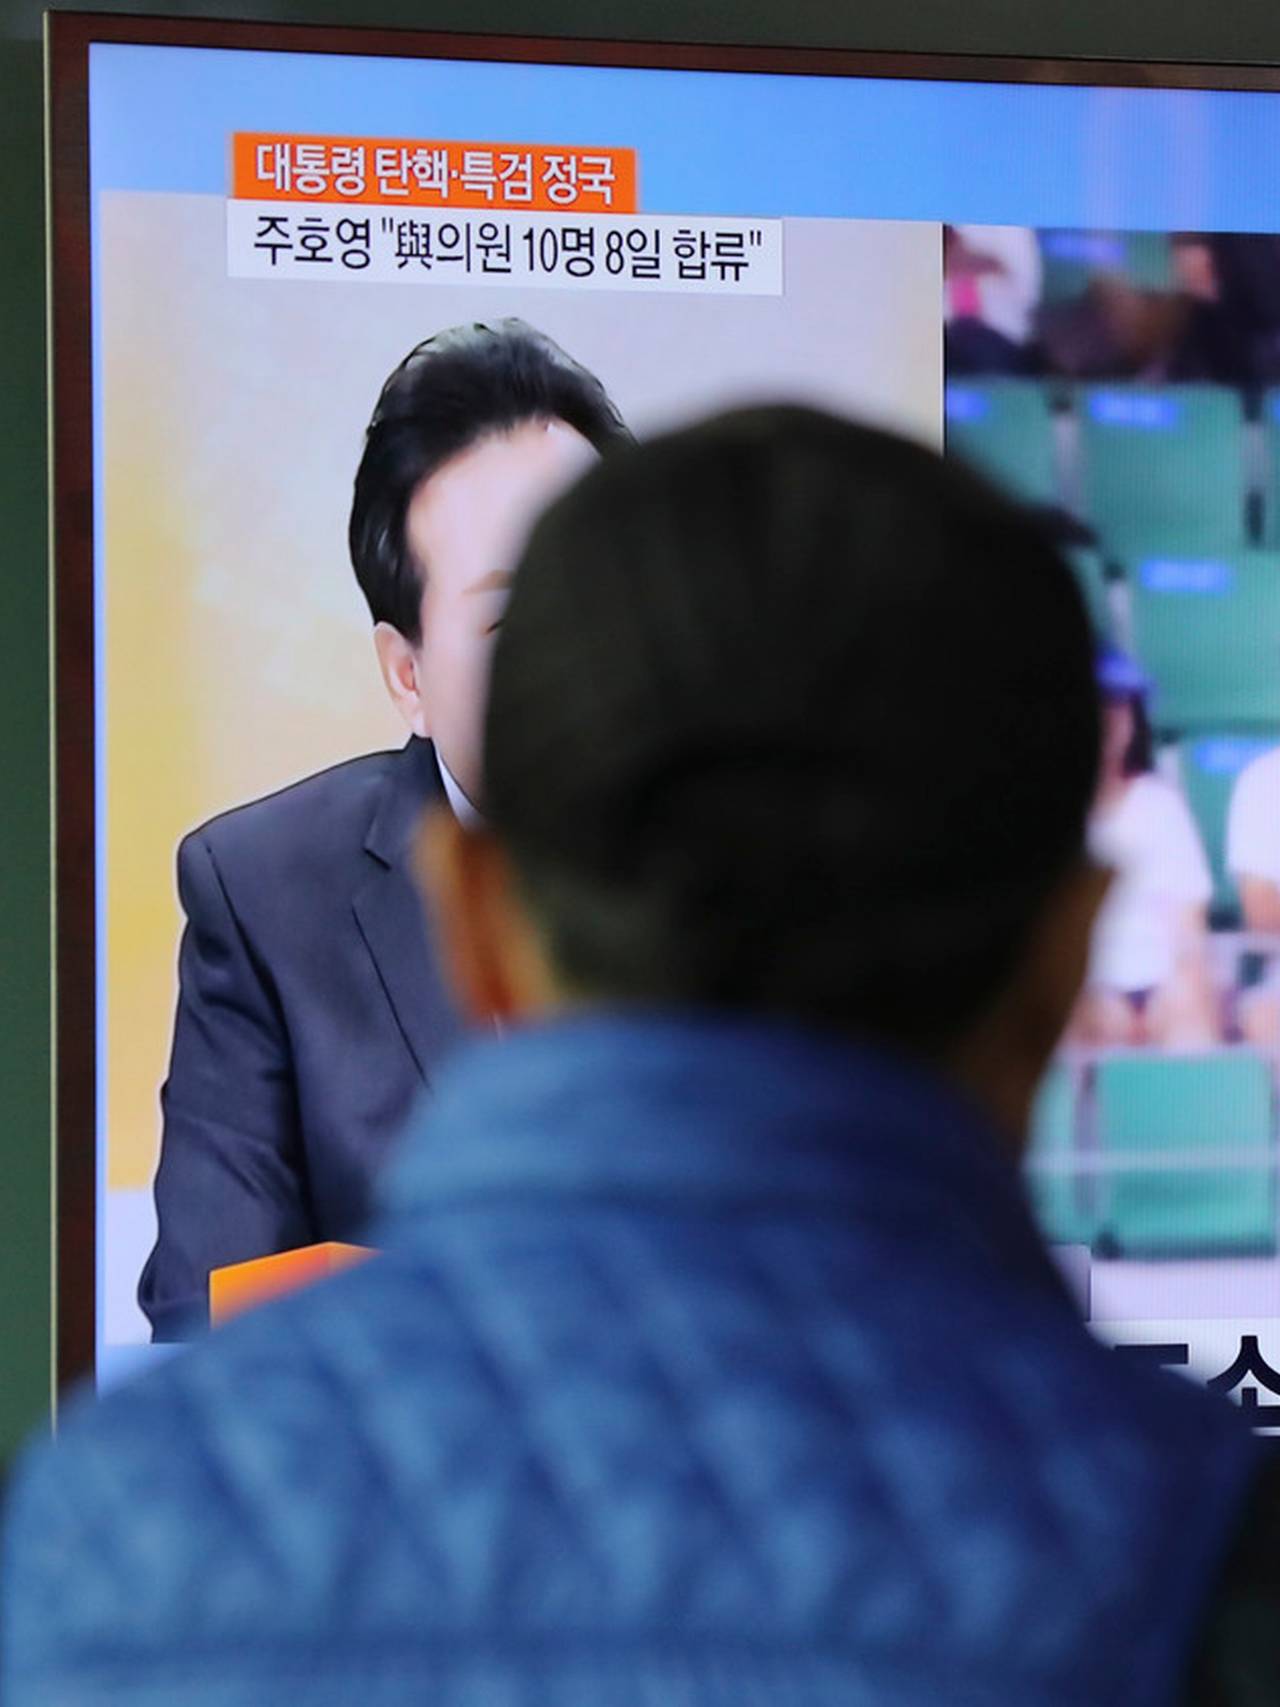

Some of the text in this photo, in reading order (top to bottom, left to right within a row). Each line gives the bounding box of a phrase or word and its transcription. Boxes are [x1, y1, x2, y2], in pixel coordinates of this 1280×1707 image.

[255, 142, 366, 196] 대통령
[541, 153, 616, 205] 정국
[253, 216, 371, 270] 주호영
[522, 226, 597, 278] 10명
[604, 228, 661, 280] 8일
[671, 229, 763, 283] 합류"
